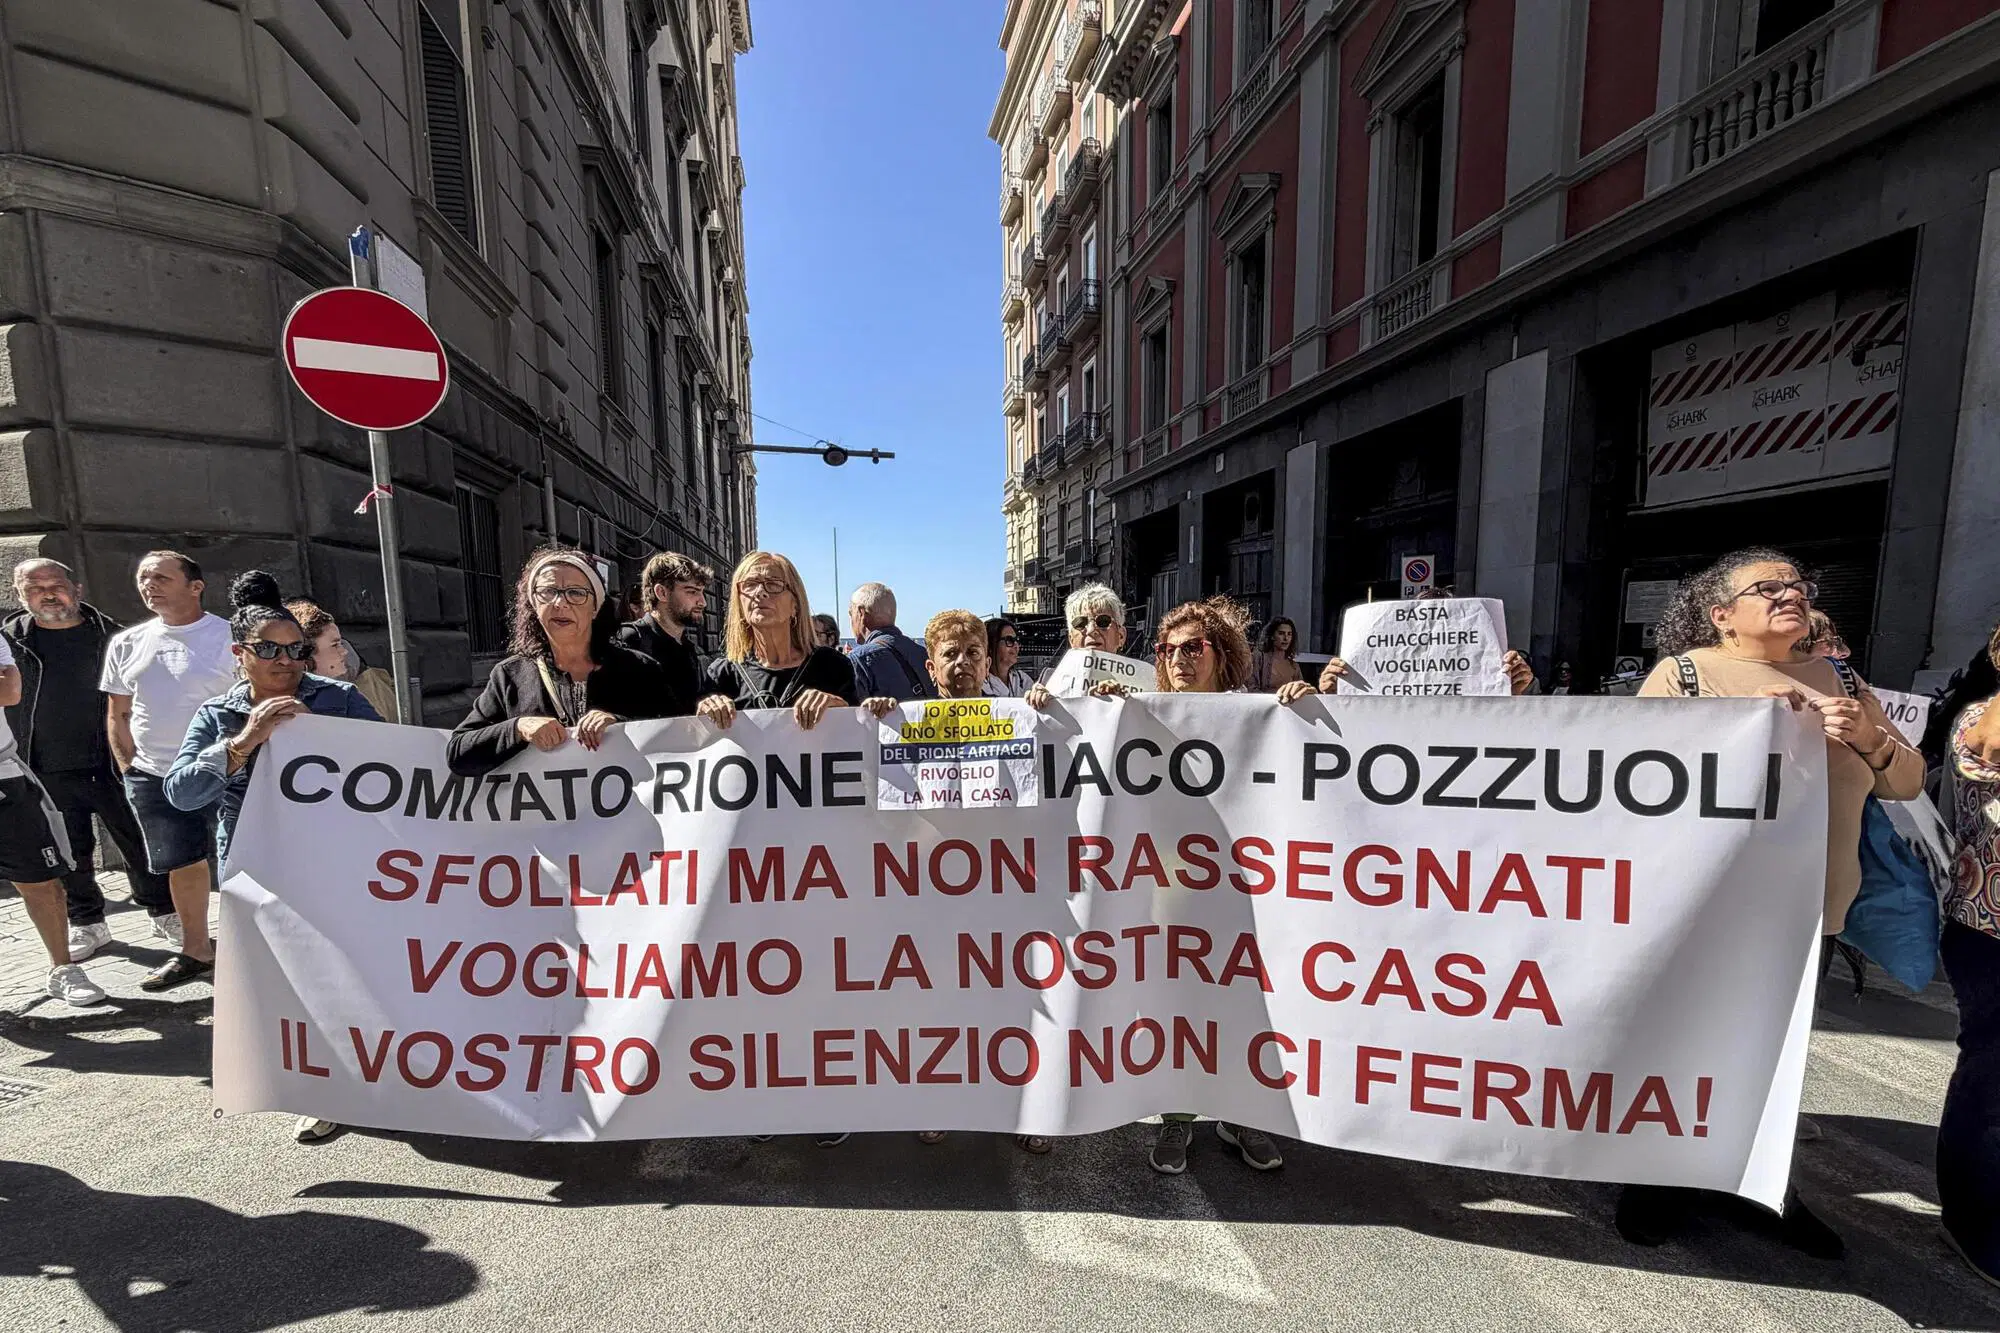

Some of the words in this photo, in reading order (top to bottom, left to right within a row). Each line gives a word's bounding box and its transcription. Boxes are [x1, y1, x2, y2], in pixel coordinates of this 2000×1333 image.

[1395, 605, 1450, 622] BASTA
[1366, 630, 1479, 648] CHIACCHIERE
[1083, 655, 1136, 676] DIETRO
[1374, 657, 1471, 674] VOGLIAMO
[1382, 682, 1463, 696] CERTEZZE
[924, 706, 940, 718] IO
[948, 704, 991, 717] SONO
[901, 726, 936, 739] UNO
[943, 723, 1014, 739] SFOLLATO
[883, 748, 911, 761] DEL
[918, 746, 966, 760] RIONE
[968, 742, 1032, 759] ARTIACO
[280, 754, 634, 822] COMITATO
[653, 750, 867, 815] RIONE
[1042, 737, 1226, 800] IACO
[1302, 742, 1782, 821] POZZUOLI
[920, 766, 995, 781] RIVOGLIO
[903, 791, 923, 804] LA
[931, 790, 962, 803] MIA
[971, 788, 1013, 802] CASA
[368, 848, 699, 908] SFOLLATI
[729, 844, 849, 904] MA
[874, 838, 1037, 898] NON
[1068, 832, 1632, 926] RASSEGNATI
[406, 937, 802, 1000] VOGLIAMO
[835, 933, 933, 991] LA
[957, 925, 1274, 993] NOSTRA
[1301, 941, 1563, 1026] CASA
[280, 1018, 331, 1079] IL
[348, 1026, 660, 1096] VOSTRO
[689, 1026, 1040, 1092] SILENZIO
[1069, 1015, 1218, 1088] NON
[1247, 1031, 1322, 1098] CI
[1355, 1045, 1714, 1138] FERMA!
